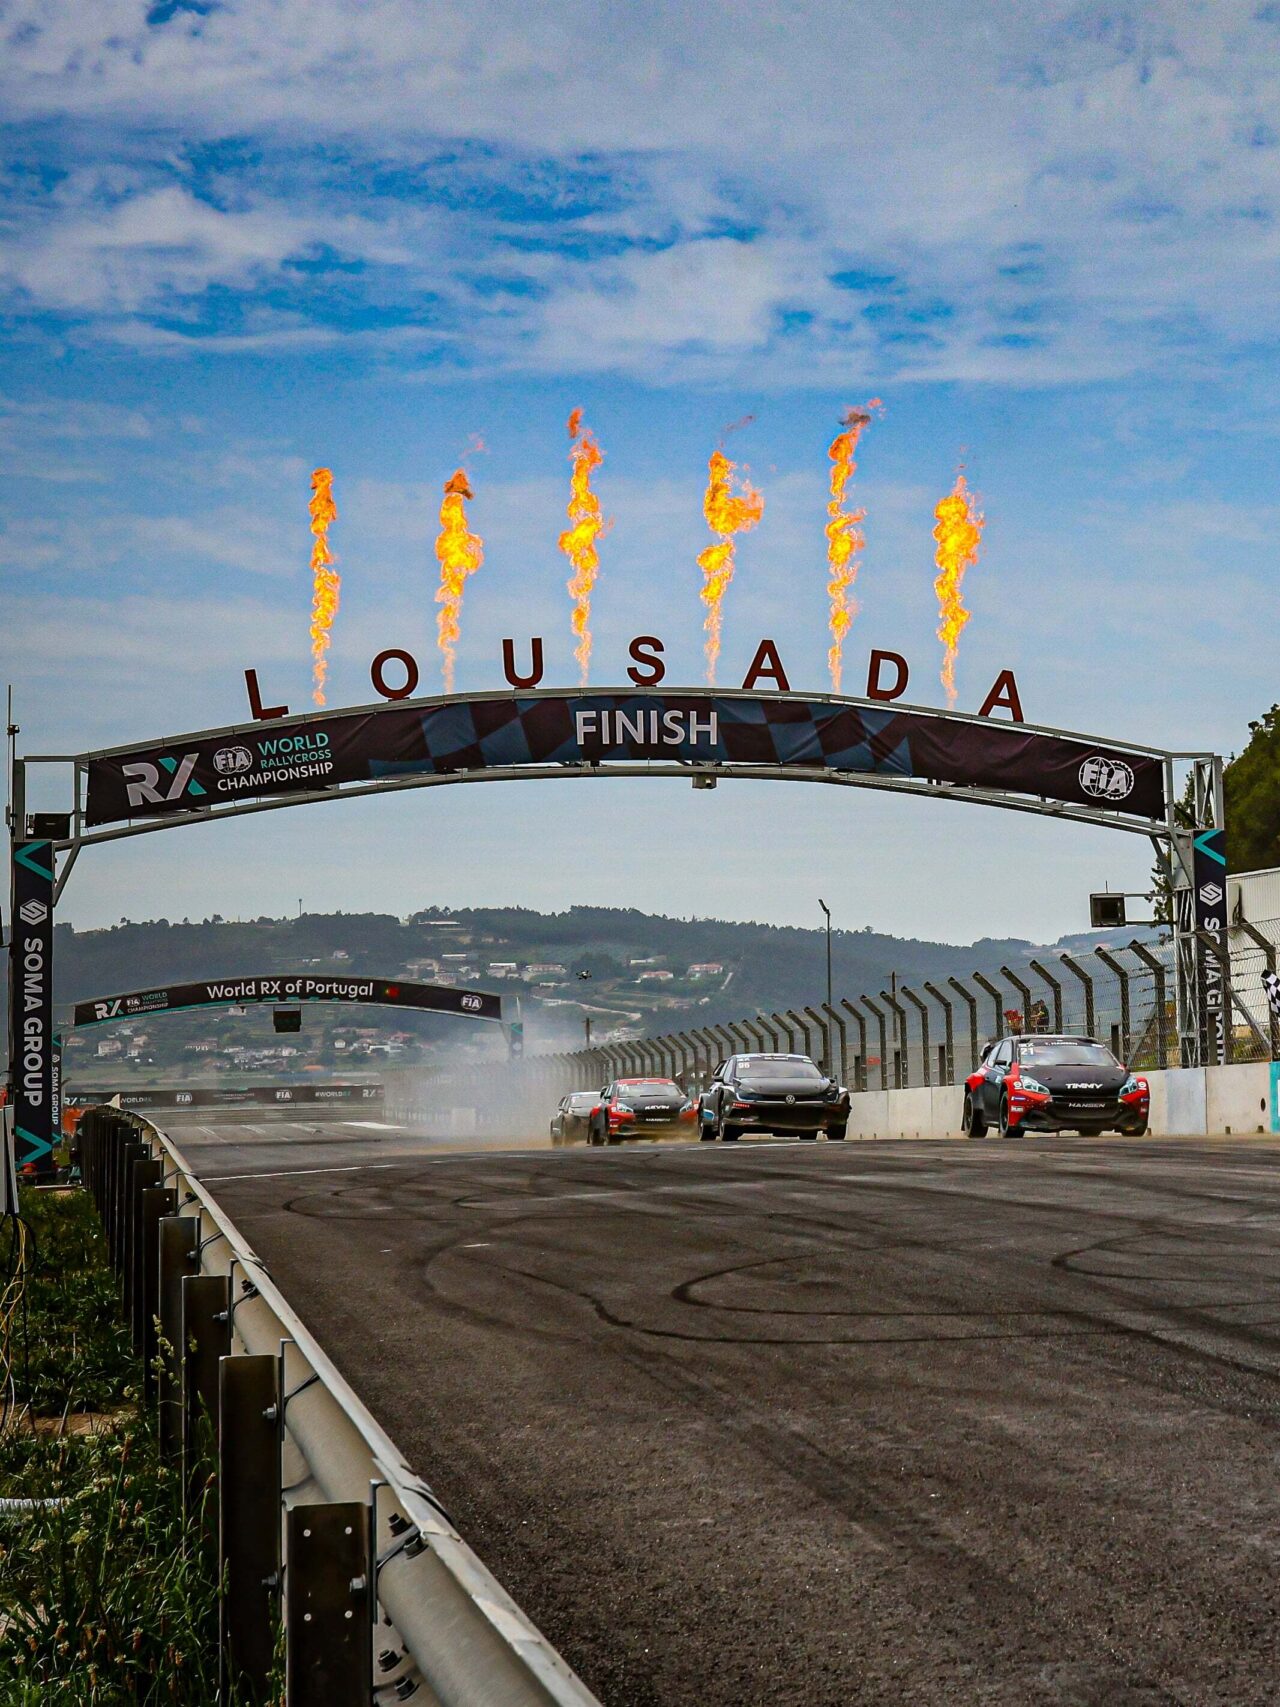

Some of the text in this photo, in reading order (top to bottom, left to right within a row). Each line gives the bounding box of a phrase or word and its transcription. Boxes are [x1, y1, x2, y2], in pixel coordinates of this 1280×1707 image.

[575, 710, 718, 746] FINISH
[257, 733, 329, 755] WORLD
[260, 749, 332, 769] RALLYCROSS
[122, 752, 207, 807] RX
[217, 762, 334, 791] CHAMPIONSHIP
[206, 980, 374, 999] World RX of Portugal
[94, 999, 122, 1019] RX
[24, 937, 43, 1107] SOMA GROUP
[1020, 1047, 1034, 1055] 21
[51, 1066, 59, 1125] SOMA GROUP
